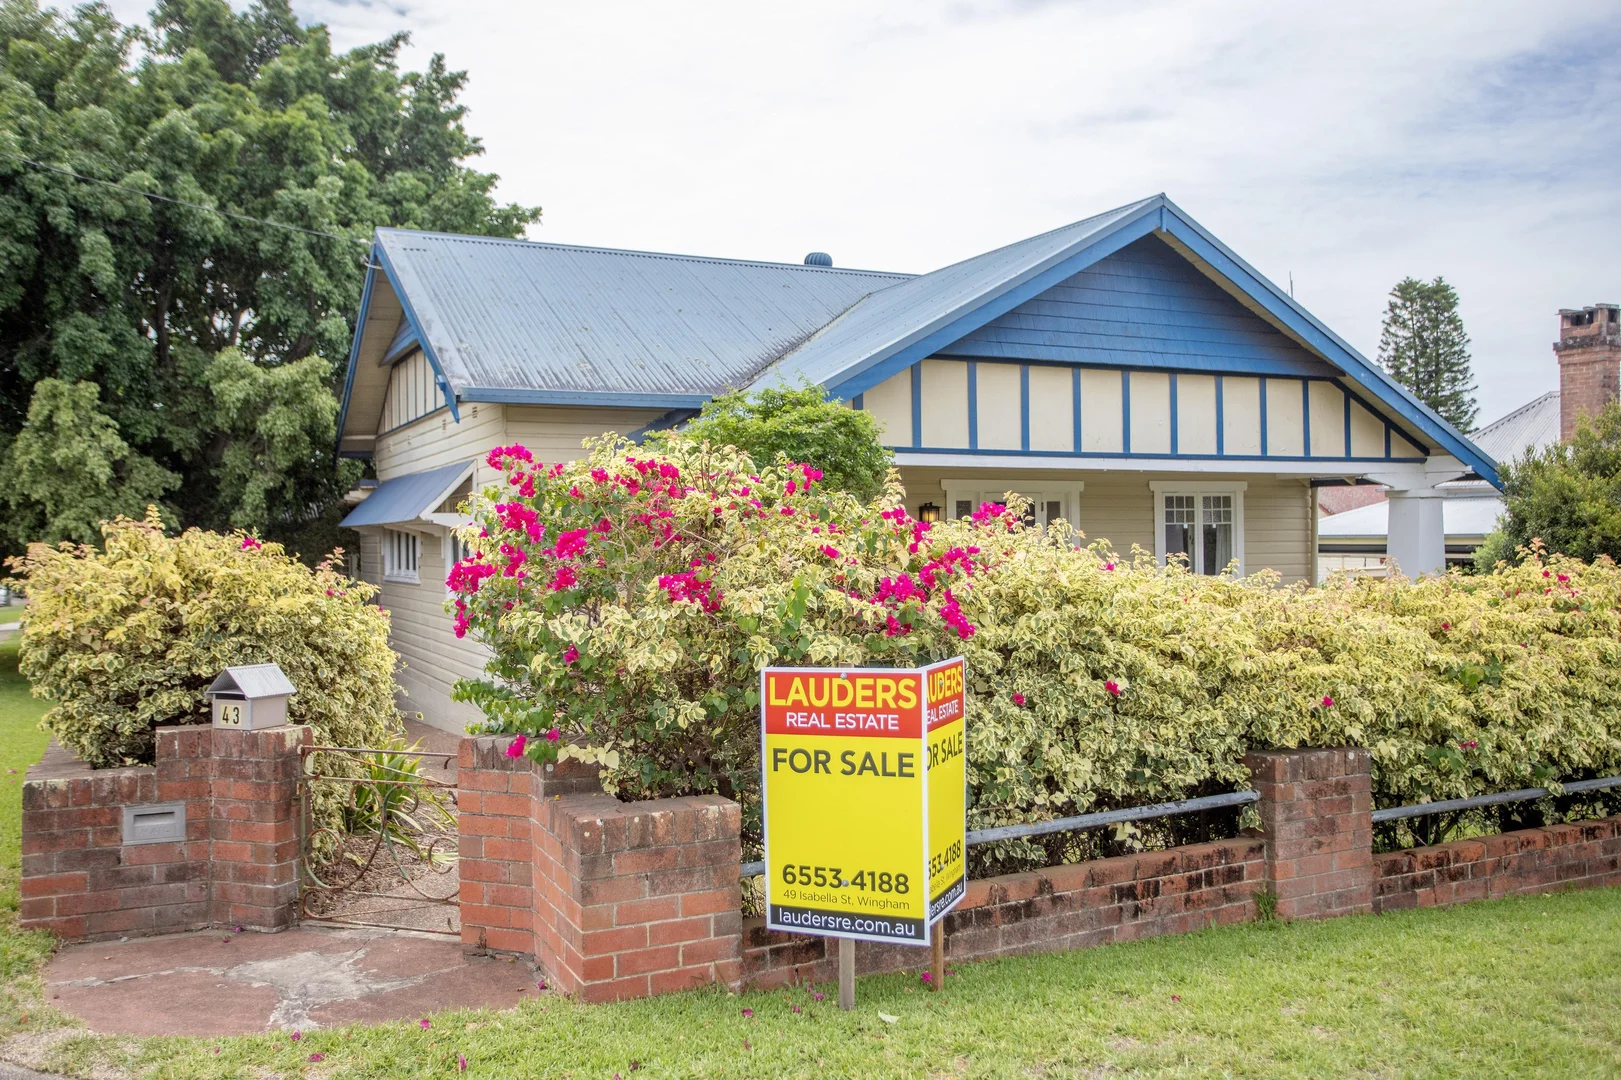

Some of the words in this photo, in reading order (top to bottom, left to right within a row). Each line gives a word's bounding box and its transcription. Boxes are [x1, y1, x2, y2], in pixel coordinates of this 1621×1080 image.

[769, 676, 917, 709] LAUDERS
[222, 706, 240, 724] 43
[786, 712, 830, 728] REAL
[835, 713, 899, 730] ESTATE
[939, 699, 959, 720] ESTATE
[941, 731, 963, 763] SALE
[772, 747, 831, 774] FOR
[840, 750, 915, 778] SALE
[944, 839, 961, 867] 4188
[782, 864, 842, 889] 6553
[851, 870, 910, 894] 4188
[783, 889, 797, 900] 49
[799, 890, 838, 904] Isabella
[840, 894, 854, 906] St,
[856, 896, 910, 911] Wingham
[779, 908, 915, 936] laudersre.com.au
